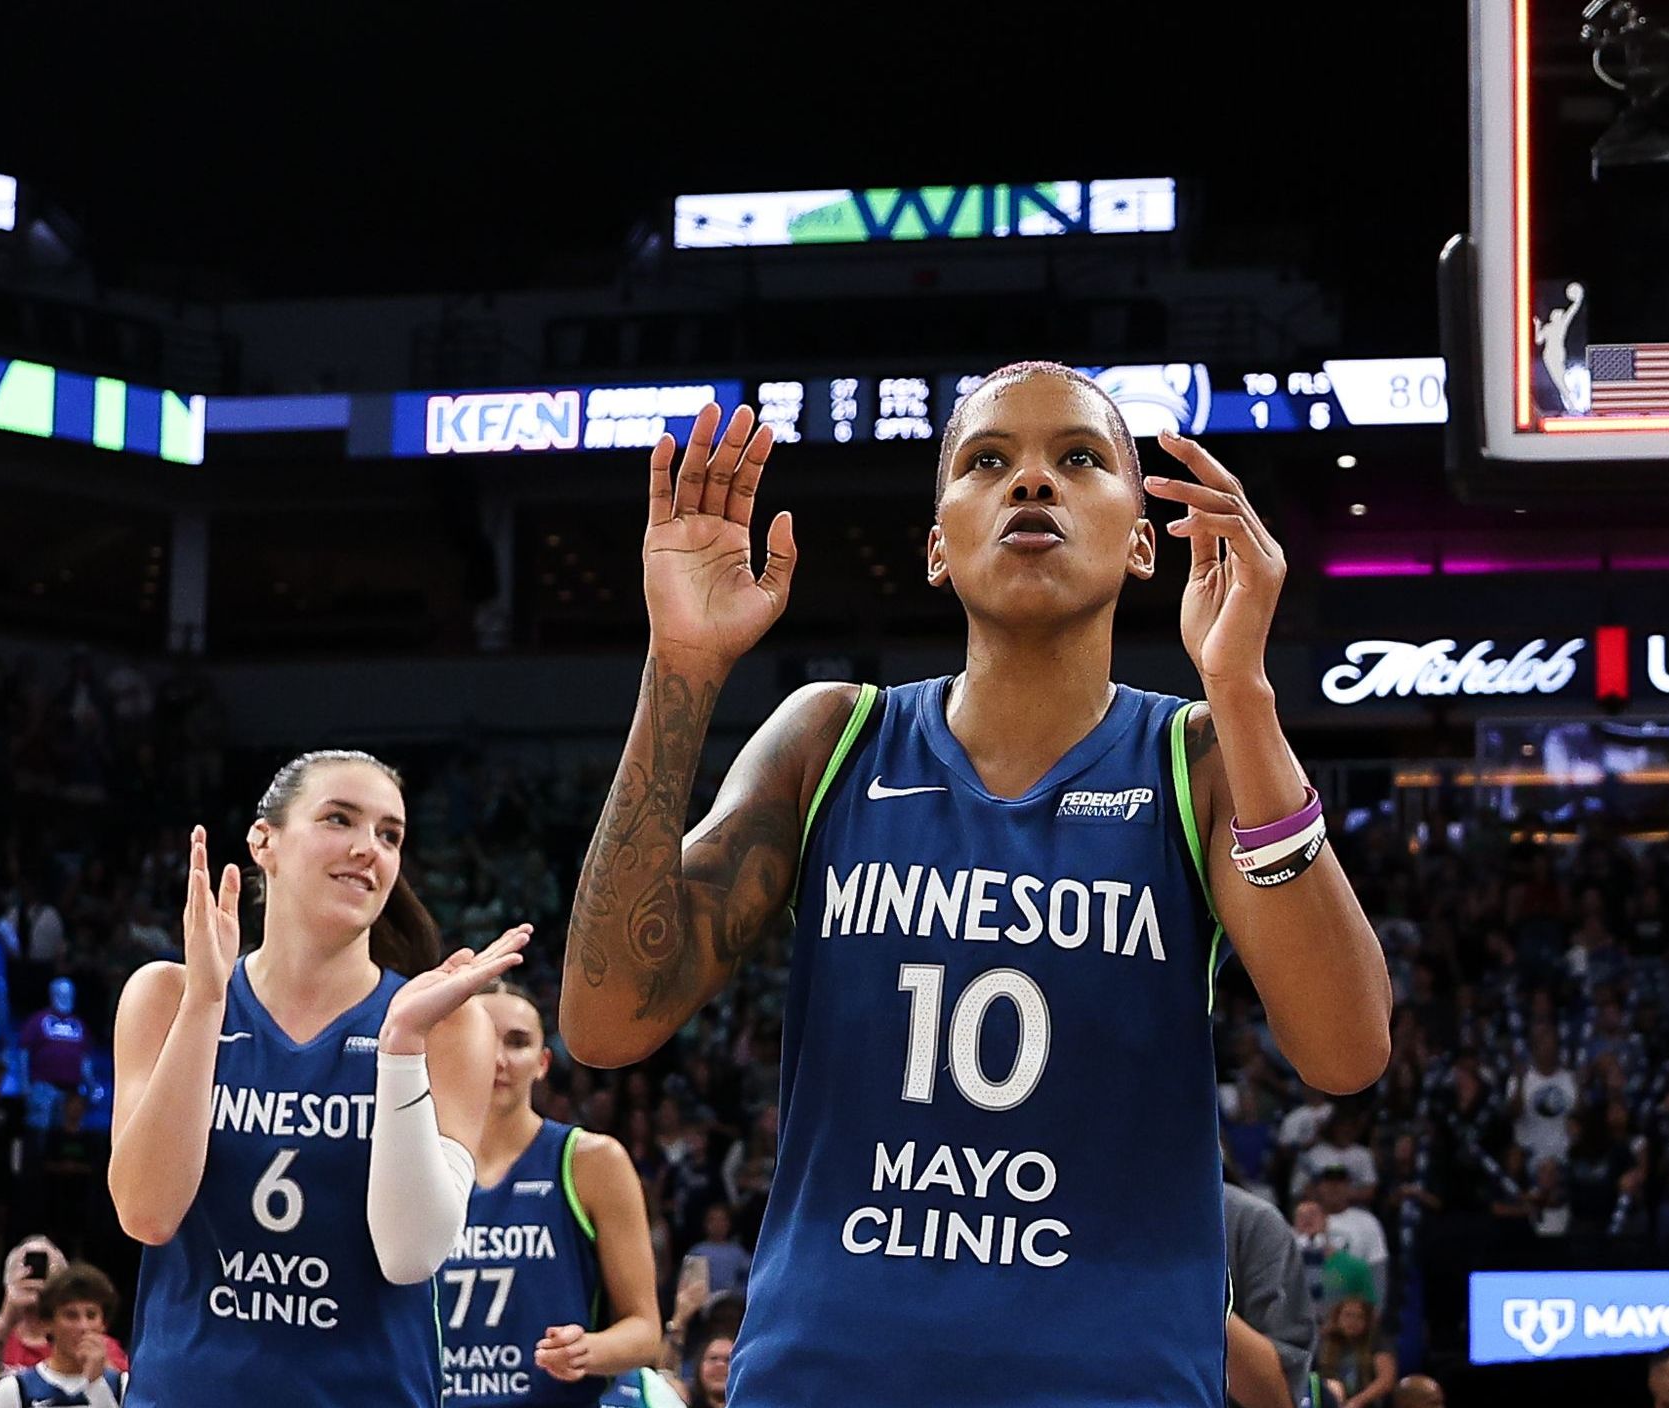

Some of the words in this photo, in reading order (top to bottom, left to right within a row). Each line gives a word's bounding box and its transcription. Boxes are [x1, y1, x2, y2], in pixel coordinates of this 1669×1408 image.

[1388, 374, 1441, 409] 80
[431, 395, 575, 451] KFAN
[1322, 637, 1585, 704] Michelob
[1055, 805, 1122, 817] INSURANCE
[1059, 787, 1154, 807] FEDERATED
[820, 862, 1167, 961] MINNESOTA
[897, 963, 1051, 1111] 10
[252, 1148, 305, 1234] 6
[872, 1140, 1057, 1203] MAYO
[841, 1207, 1071, 1268] CLINIC
[218, 1248, 330, 1290] MAYO
[208, 1285, 339, 1330] CLINIC
[443, 1268, 516, 1329] 77
[444, 1345, 523, 1370] MAYO
